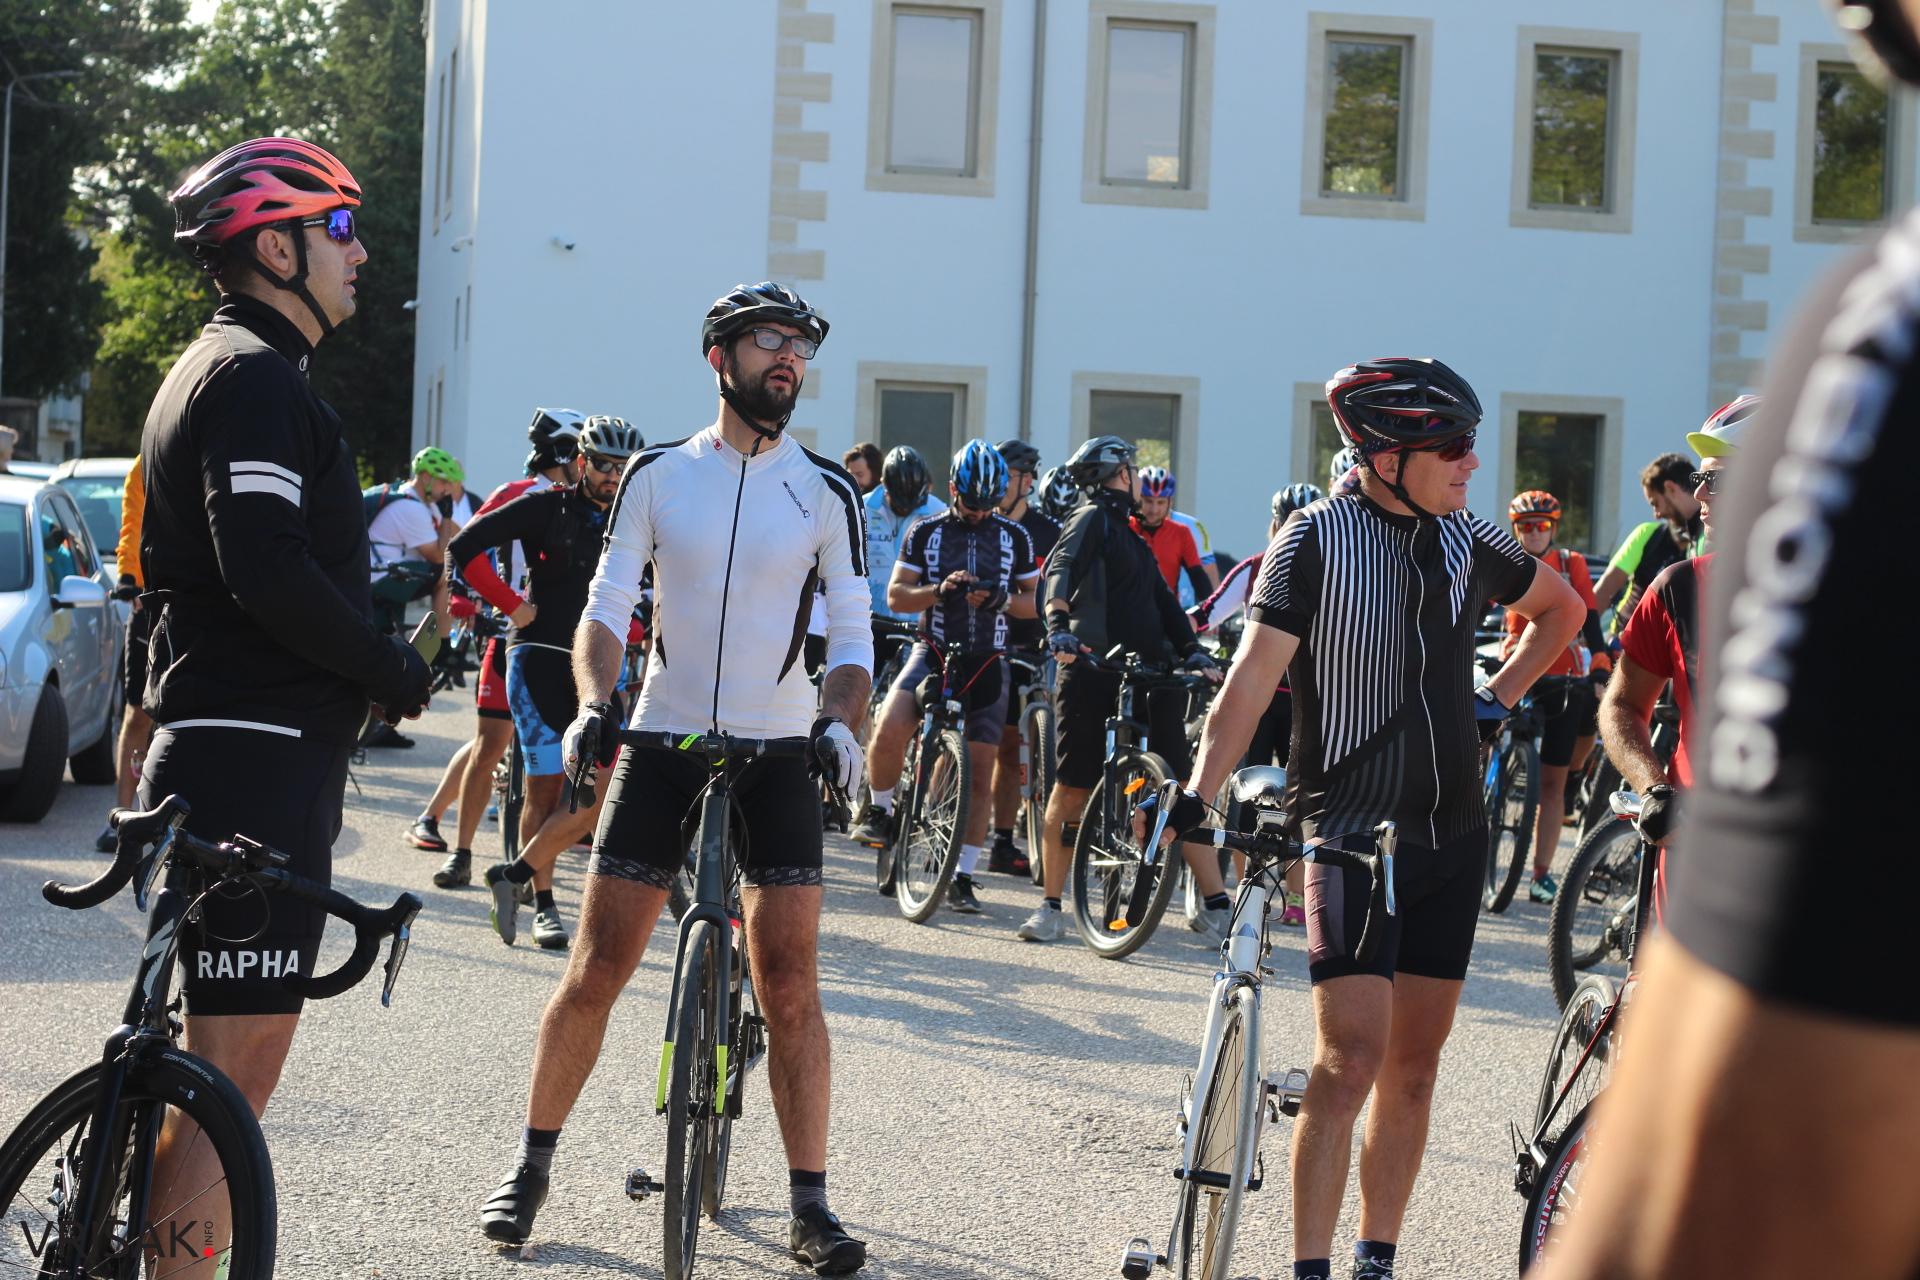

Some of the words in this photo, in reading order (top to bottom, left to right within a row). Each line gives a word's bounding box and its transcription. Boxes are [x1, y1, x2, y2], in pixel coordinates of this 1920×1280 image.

[197, 950, 299, 979] RAPHA
[162, 1053, 215, 1085] CONTINENTAL
[1551, 1161, 1571, 1191] seven
